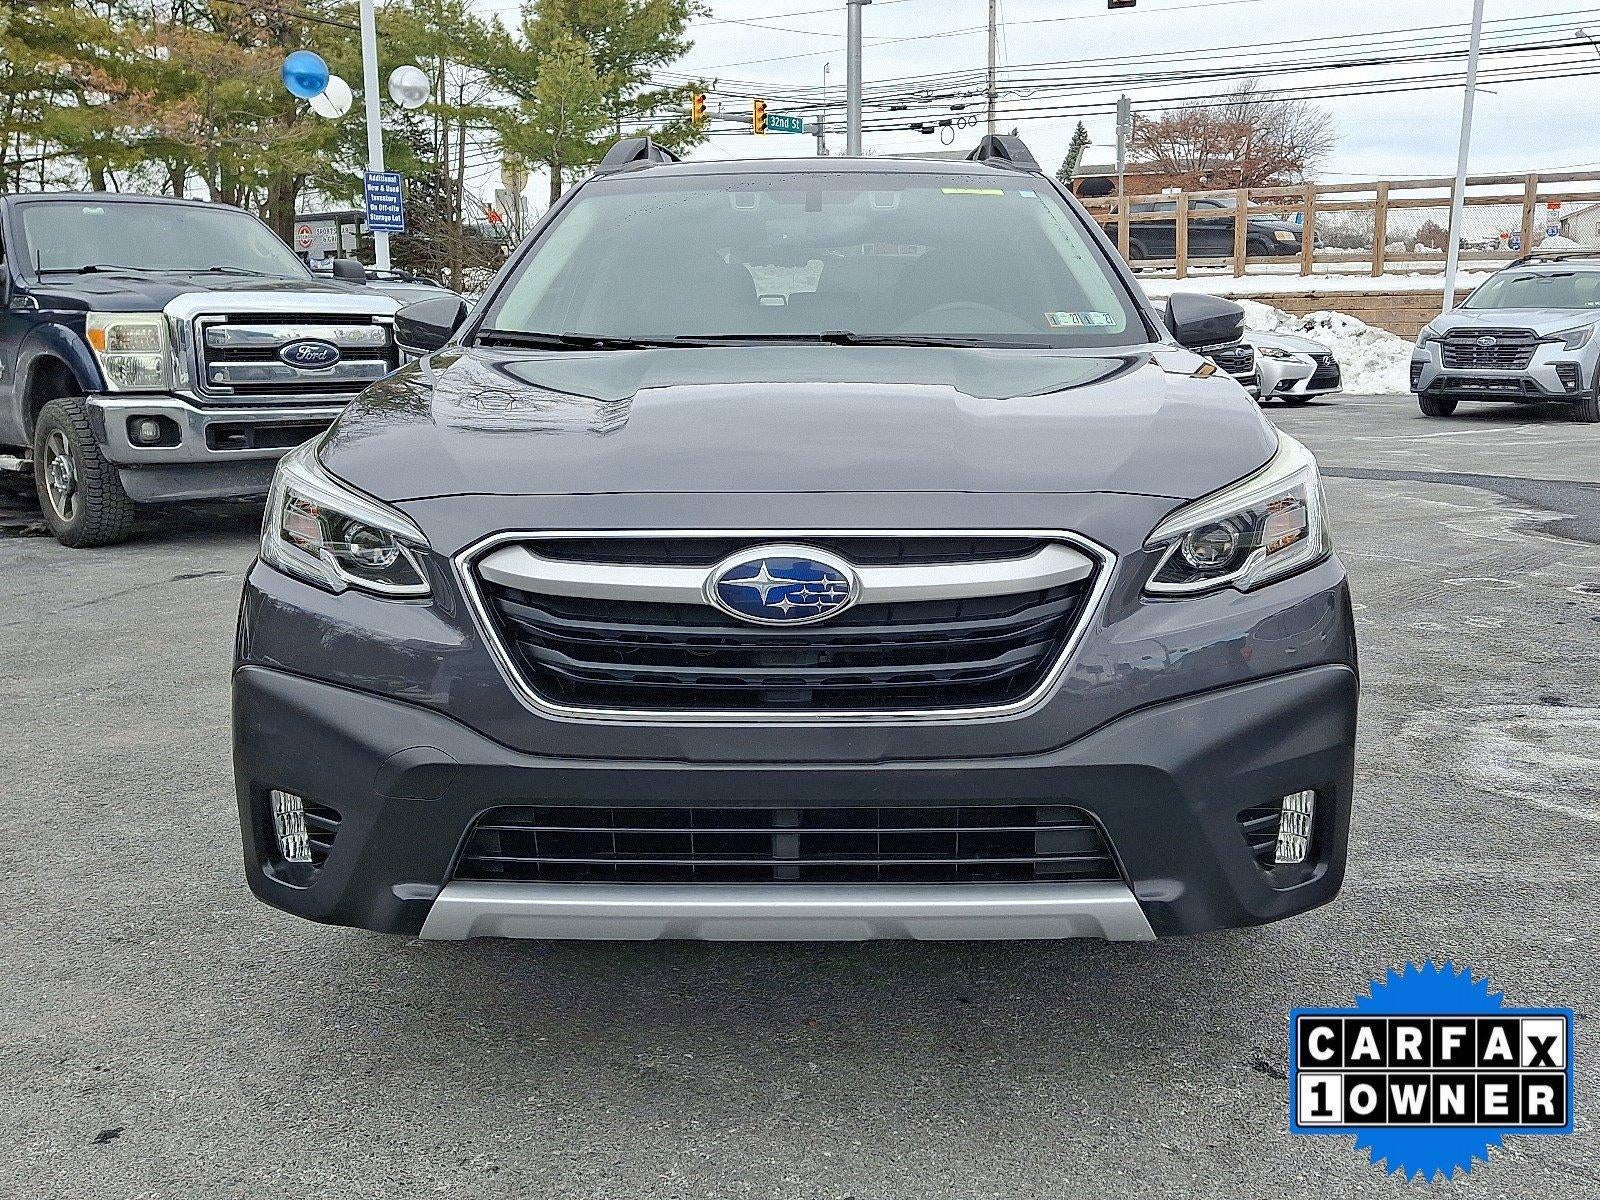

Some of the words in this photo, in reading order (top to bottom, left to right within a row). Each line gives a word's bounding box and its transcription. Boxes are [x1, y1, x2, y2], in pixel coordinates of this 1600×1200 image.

[770, 116, 789, 128] 32nd
[792, 119, 800, 130] St
[368, 174, 397, 183] Additional
[380, 184, 385, 192] &
[386, 185, 399, 193] Used
[370, 194, 397, 204] Inventory
[369, 213, 391, 223] Storage
[296, 346, 327, 360] Ford
